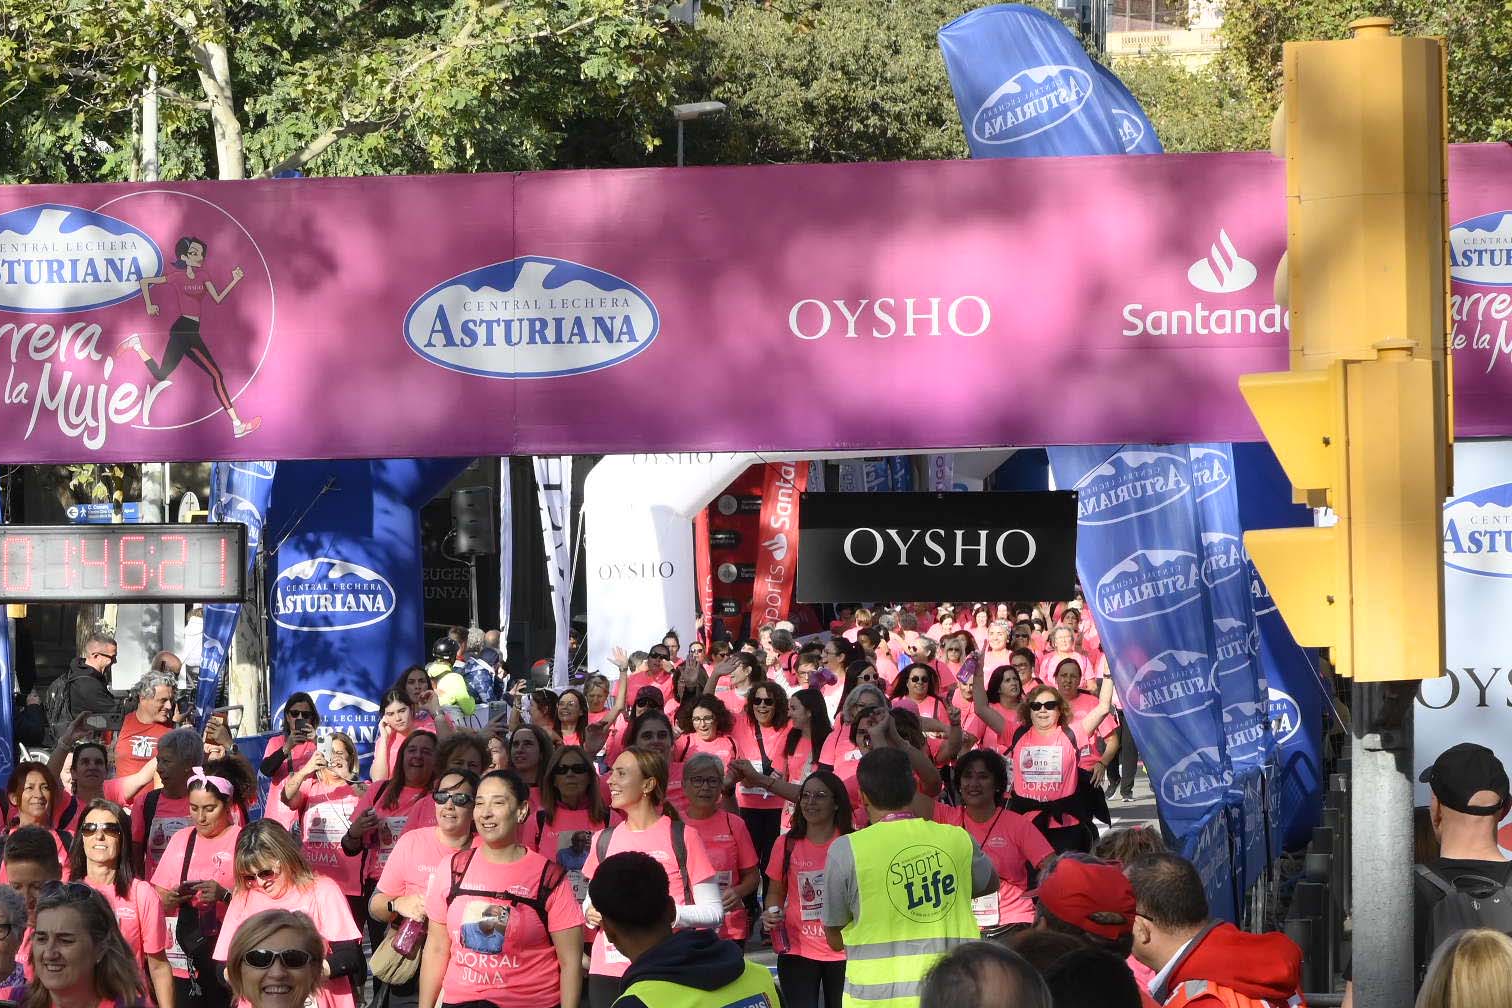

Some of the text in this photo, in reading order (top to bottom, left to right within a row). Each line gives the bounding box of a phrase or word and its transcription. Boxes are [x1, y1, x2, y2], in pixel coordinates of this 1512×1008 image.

[66, 240, 138, 252] LECHERA
[463, 297, 631, 312] CENTRAL LECHERA
[789, 296, 992, 340] OYSHO
[1122, 302, 1289, 337] Santand
[423, 304, 640, 349] ASTURIANA
[5, 366, 29, 405] la
[24, 357, 174, 451] Mujer
[2, 535, 228, 592] 01:46:21
[844, 528, 1037, 568] OYSHO
[275, 587, 387, 615] ASTURIANA
[286, 581, 382, 592] CENTRAL LECHERA
[890, 850, 944, 886] Sport
[904, 869, 956, 911] Life
[457, 951, 520, 968] DORSAL
[461, 966, 505, 985] SUMA
